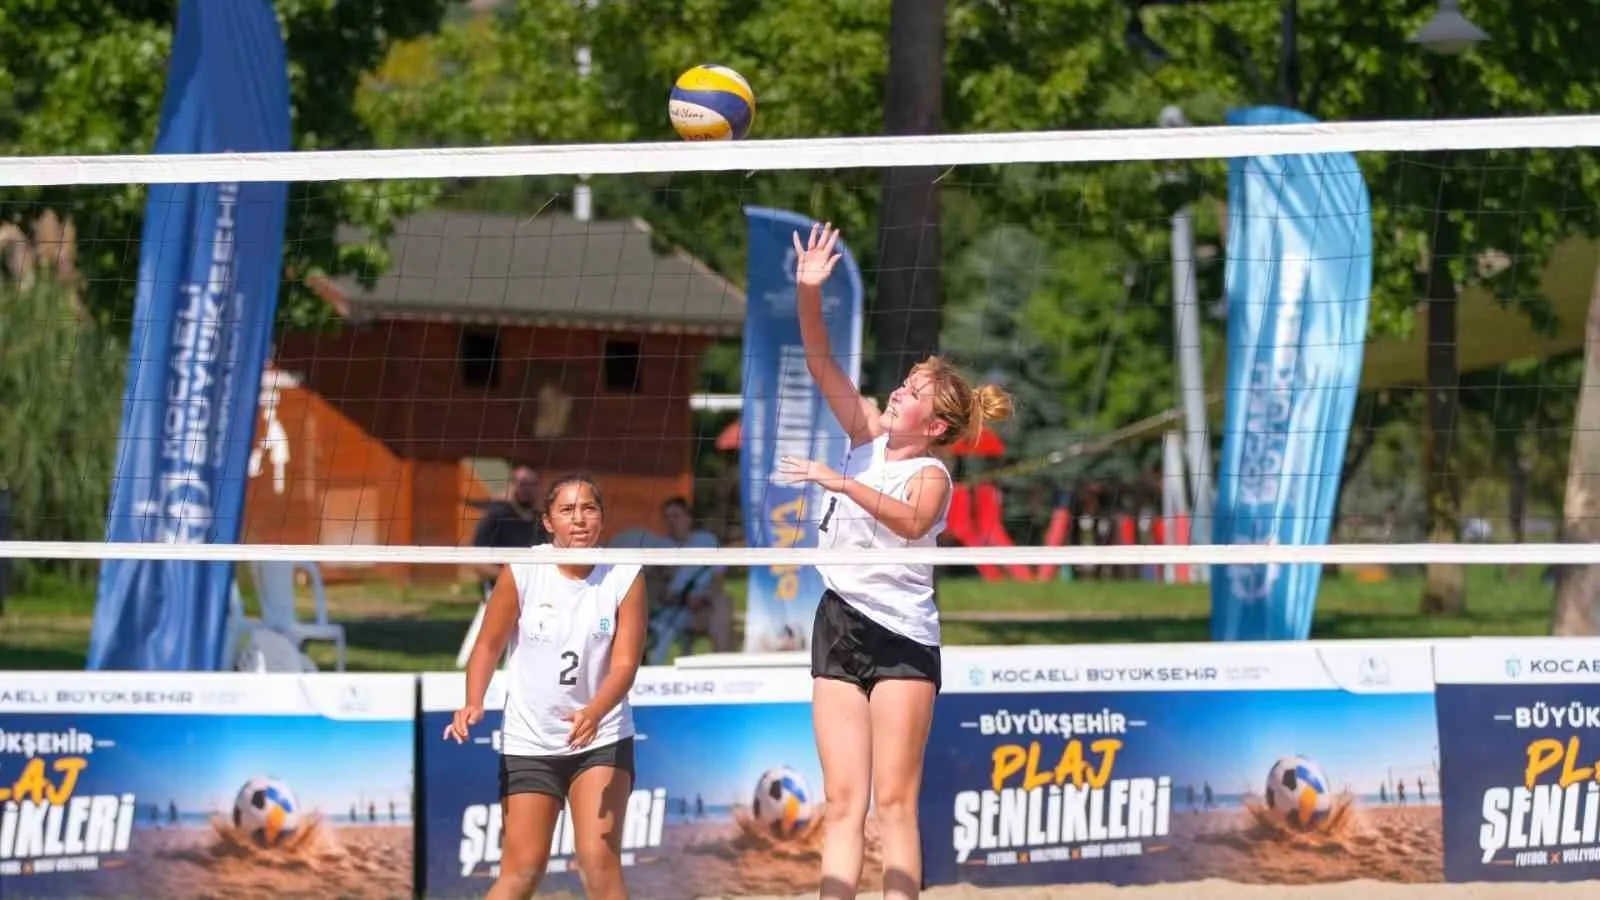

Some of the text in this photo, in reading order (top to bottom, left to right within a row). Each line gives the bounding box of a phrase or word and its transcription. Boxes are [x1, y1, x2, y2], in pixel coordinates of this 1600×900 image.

[558, 650, 579, 686] 2
[991, 667, 1080, 683] KOCAELİ
[980, 707, 1127, 739] BÜYÜKŞEHİR
[991, 738, 1123, 796] PLAJ
[1524, 735, 1600, 791] PL
[953, 776, 1171, 864] ŞENLİKLERİ
